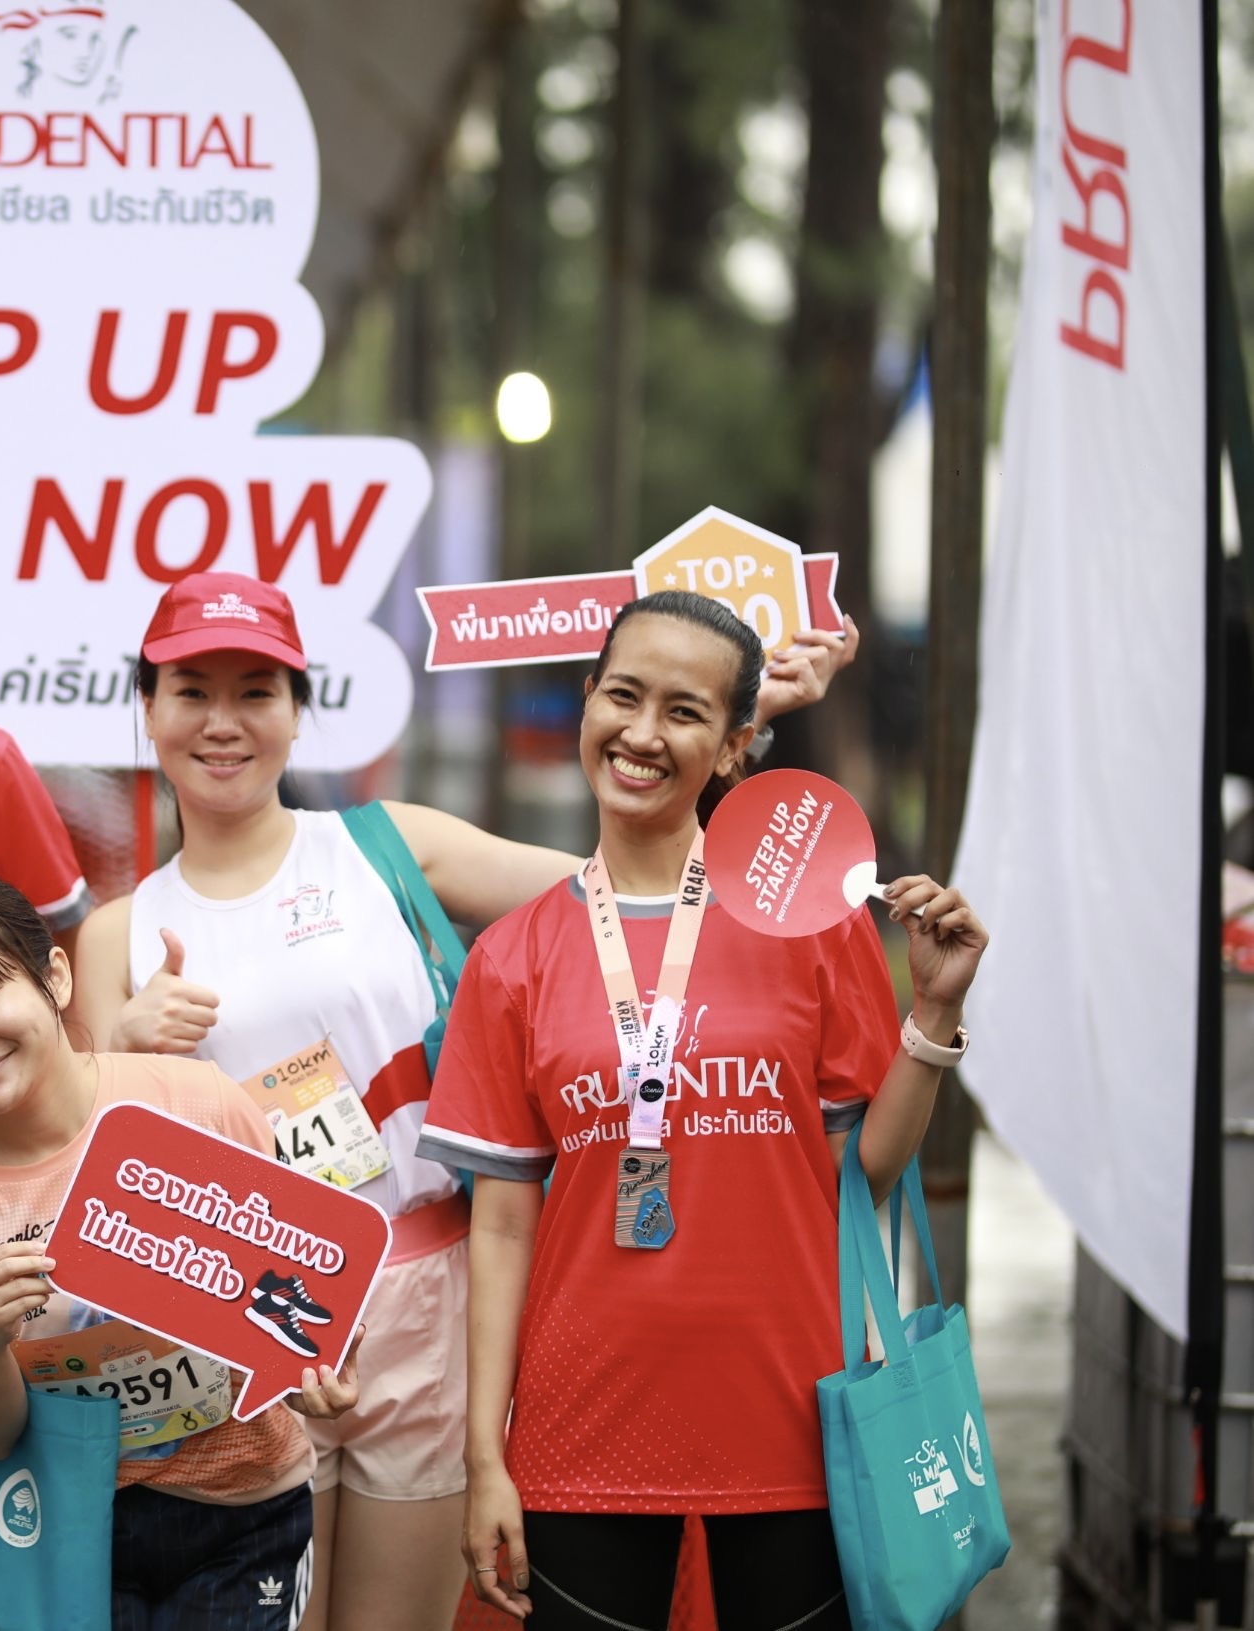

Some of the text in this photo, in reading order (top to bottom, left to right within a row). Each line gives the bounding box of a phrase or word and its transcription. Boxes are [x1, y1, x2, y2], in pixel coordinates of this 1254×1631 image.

[89, 187, 275, 226] ประกันชีวิต
[87, 310, 280, 415] UP
[18, 478, 387, 585] NOW
[677, 555, 758, 592] TOP
[746, 801, 792, 890] STEP UP
[755, 789, 819, 916] START NOW
[681, 858, 706, 906] KRABI
[616, 1000, 634, 1035] KRABI
[276, 1049, 333, 1082] 10km
[647, 1025, 666, 1068] 10km
[118, 1161, 344, 1272] รองเท้าตั้งแพง
[82, 1199, 244, 1298] ไม่แรงได้ไง
[22, 1306, 47, 1323] 024
